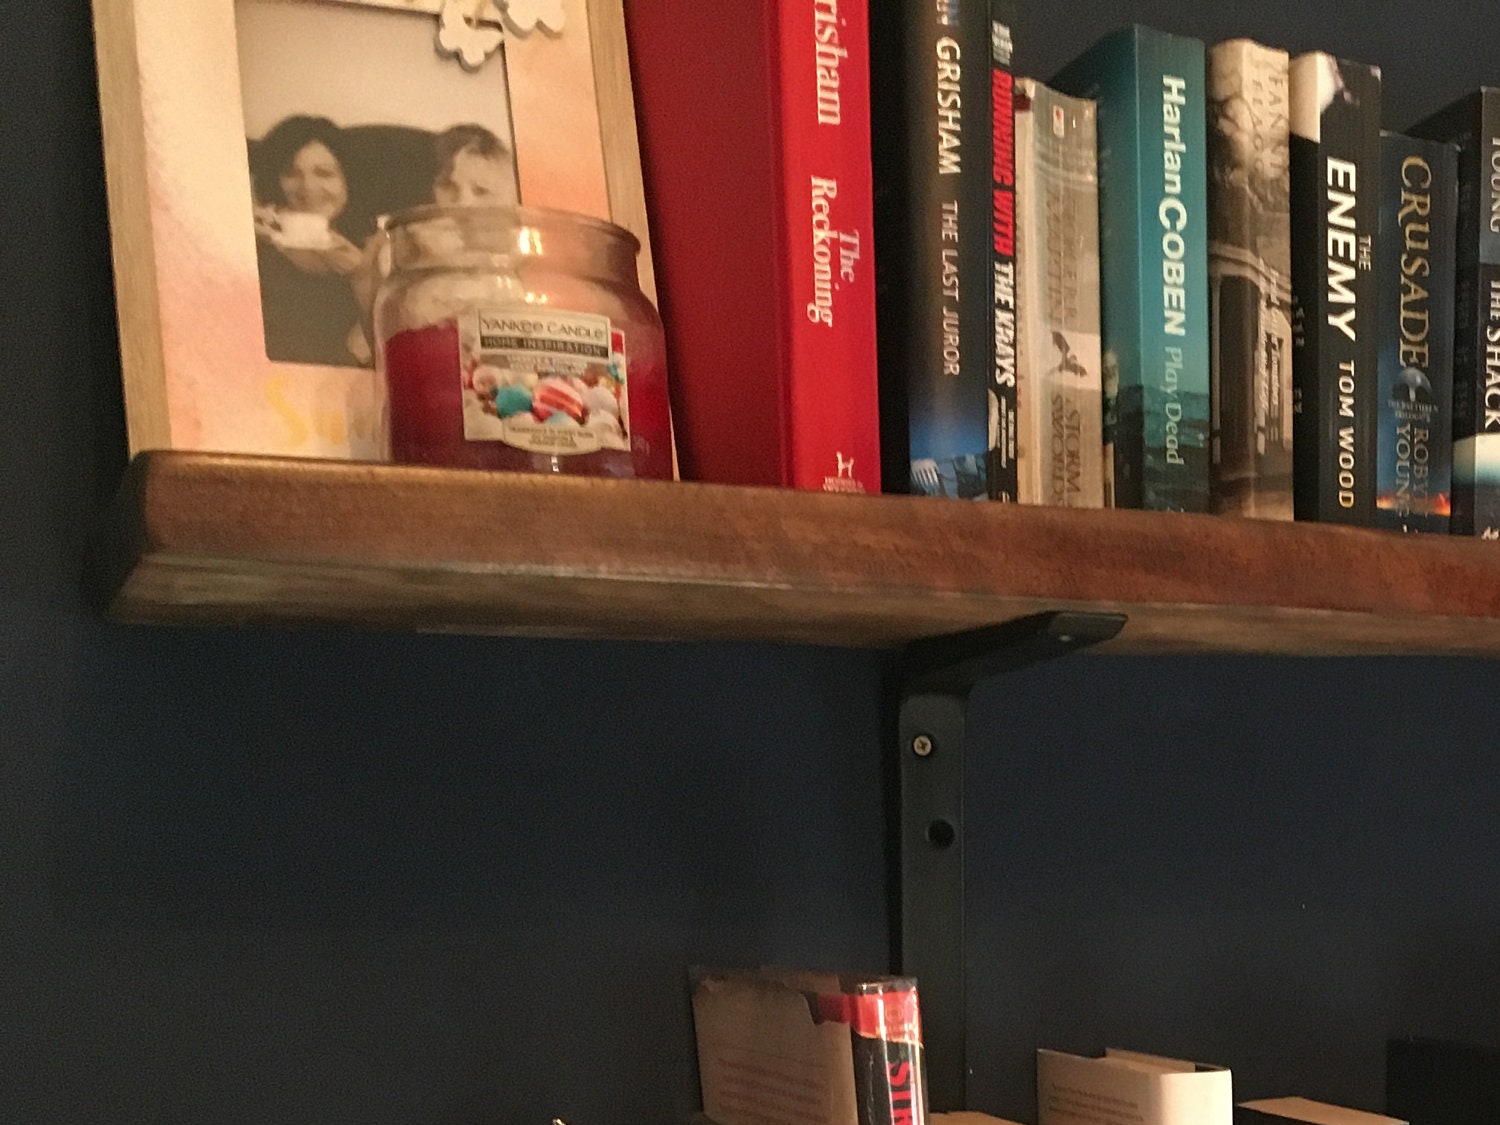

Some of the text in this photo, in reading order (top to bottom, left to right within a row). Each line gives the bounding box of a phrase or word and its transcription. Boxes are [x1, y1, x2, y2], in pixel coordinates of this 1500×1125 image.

[814, 0, 848, 125] risham
[936, 36, 961, 175] GRISHAM
[992, 68, 1014, 187] RUNNING
[807, 175, 840, 328] Reckoning
[839, 229, 860, 283] The
[993, 189, 1014, 256] WITH
[1158, 74, 1187, 337] Harlan COBEN
[1327, 157, 1358, 342] ENEMY
[1358, 235, 1372, 272] THE
[1397, 155, 1432, 368] CRUSADE
[547, 321, 604, 340] CANDLE
[941, 200, 960, 376] THE LAST JUROR
[994, 261, 1015, 308] THE
[994, 309, 1016, 388] KRAYS
[1159, 347, 1185, 466] Play Dead
[1339, 360, 1355, 509] TOM WOOD
